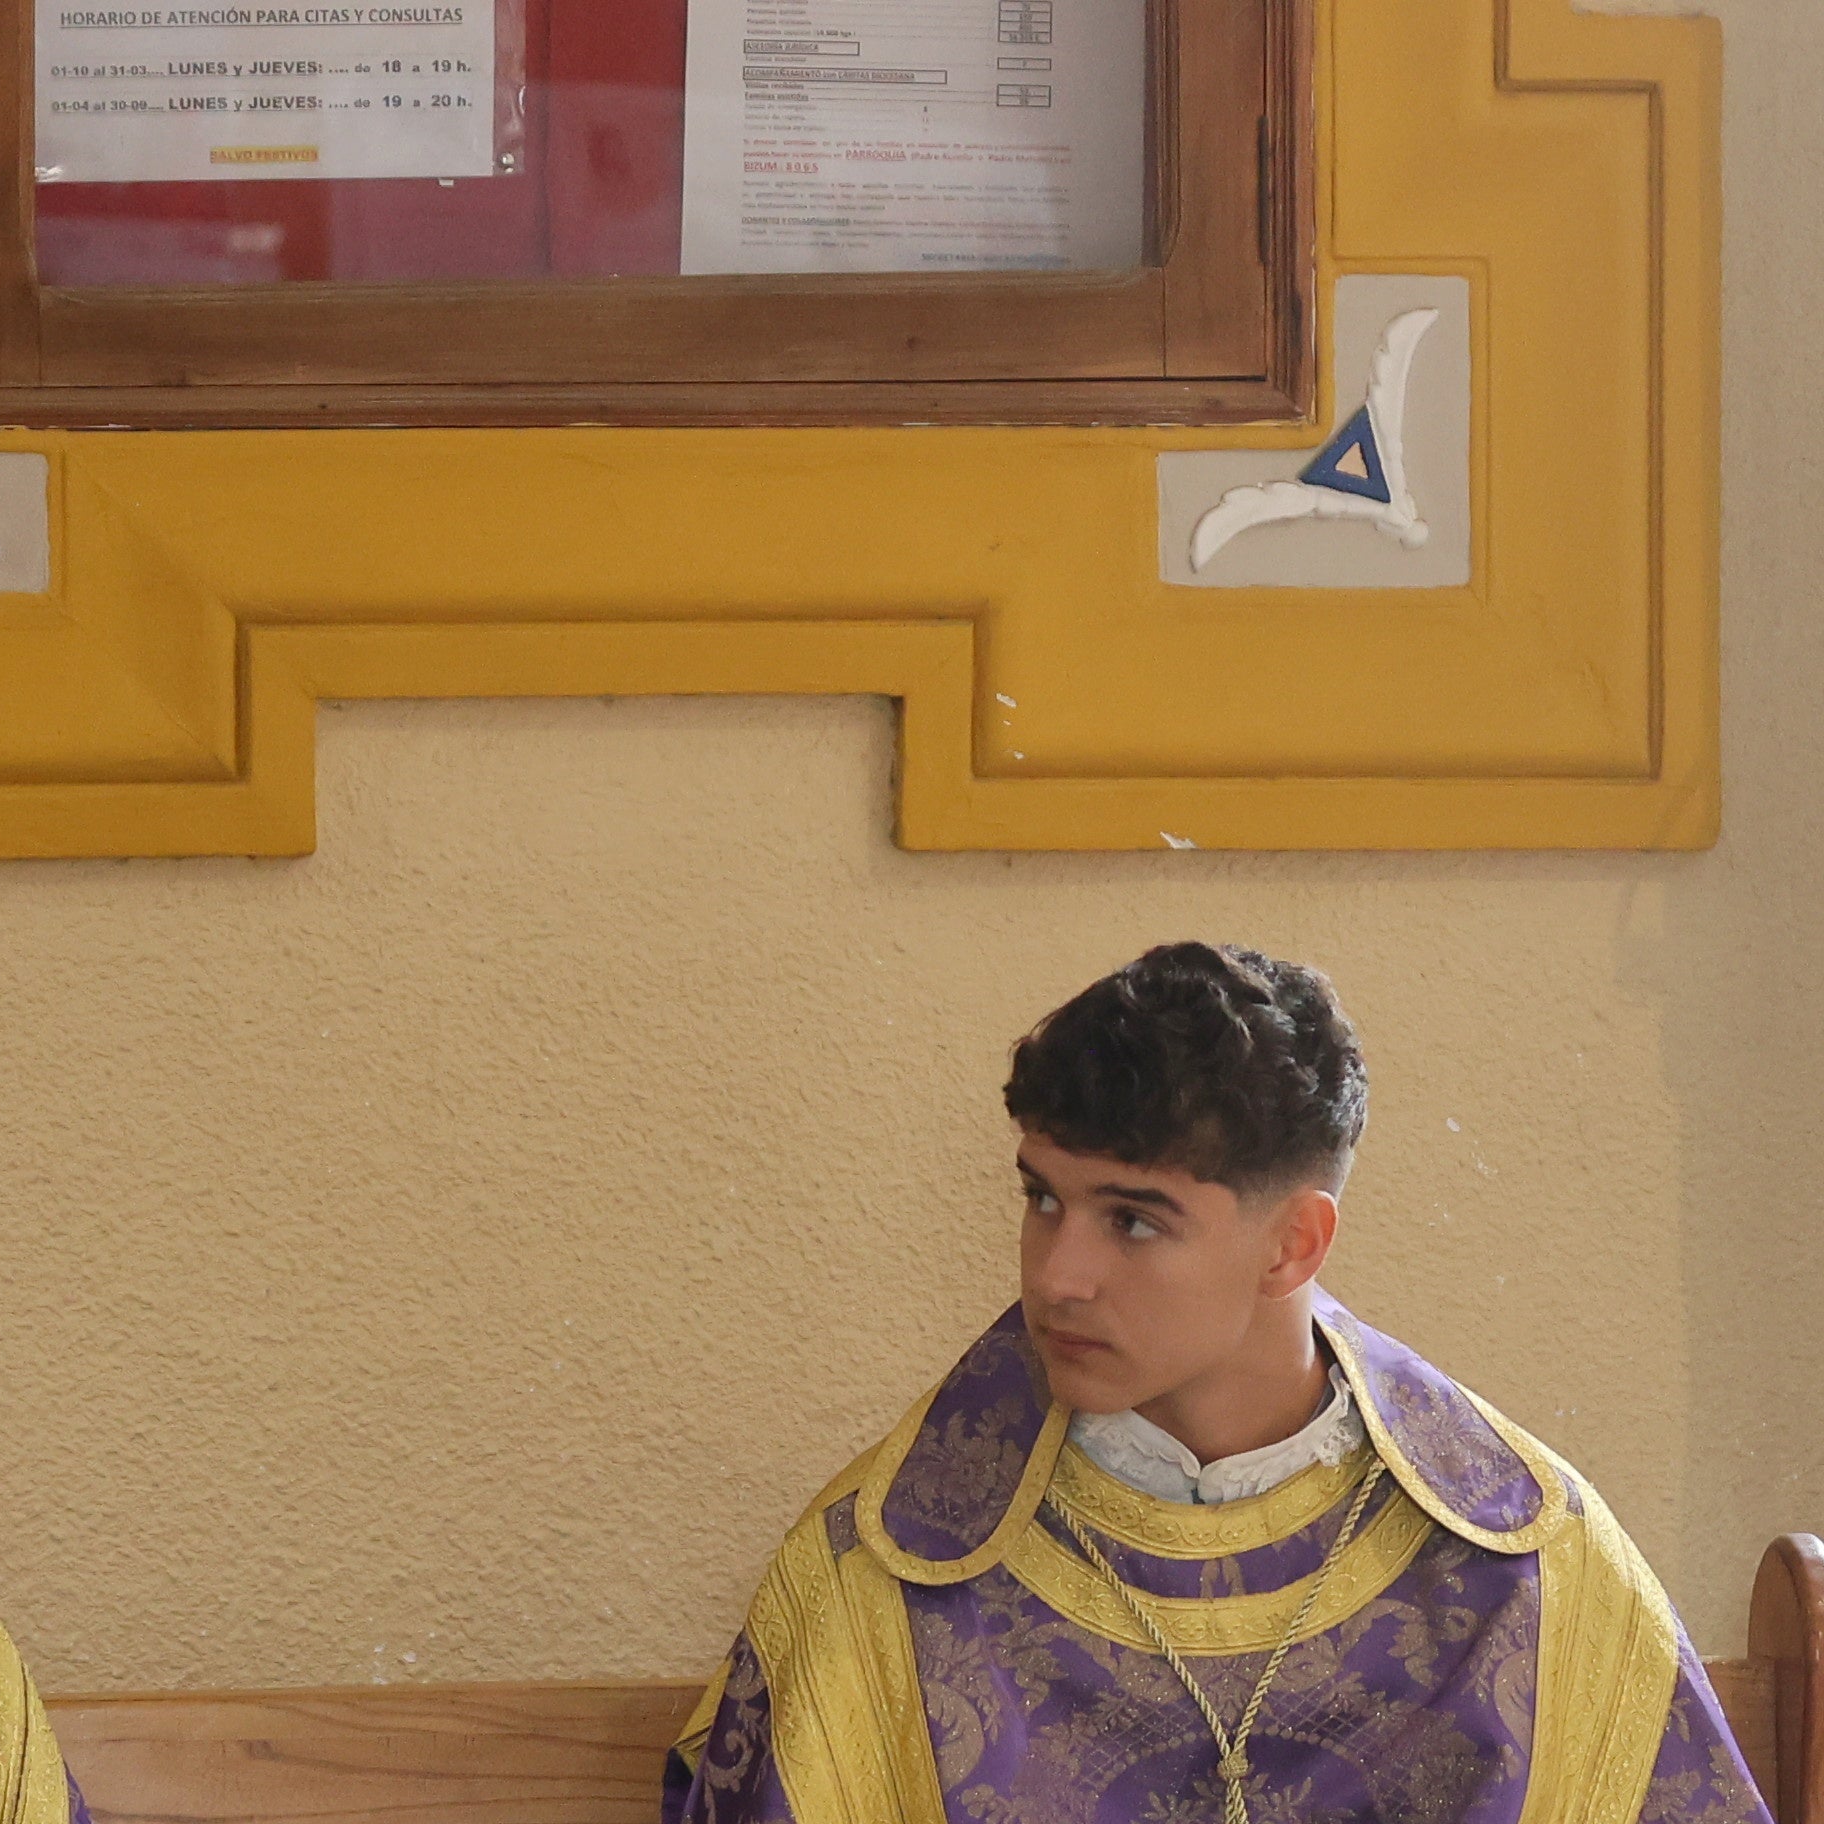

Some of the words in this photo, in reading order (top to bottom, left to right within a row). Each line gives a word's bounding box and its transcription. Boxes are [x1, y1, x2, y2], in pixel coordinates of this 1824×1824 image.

[60, 11, 137, 25] HORARIO
[141, 11, 162, 25] DE
[167, 7, 251, 24] ATENCIÓN
[256, 9, 300, 23] PARA
[305, 9, 350, 23] CITAS
[354, 8, 364, 22] Y
[368, 7, 463, 22] CONSULTAS
[51, 65, 89, 77] 01-10
[168, 62, 227, 75] LUNES
[233, 64, 243, 76] y
[249, 61, 322, 75] JUEVES:
[382, 60, 402, 73] 18
[412, 64, 420, 73] a
[432, 59, 451, 72] 19
[456, 60, 472, 73] h.
[168, 97, 227, 110] LUNES
[233, 100, 243, 112] y
[248, 95, 322, 109] JUEVES:
[382, 95, 402, 107] 19
[431, 94, 451, 107] 20
[457, 95, 473, 107] h.
